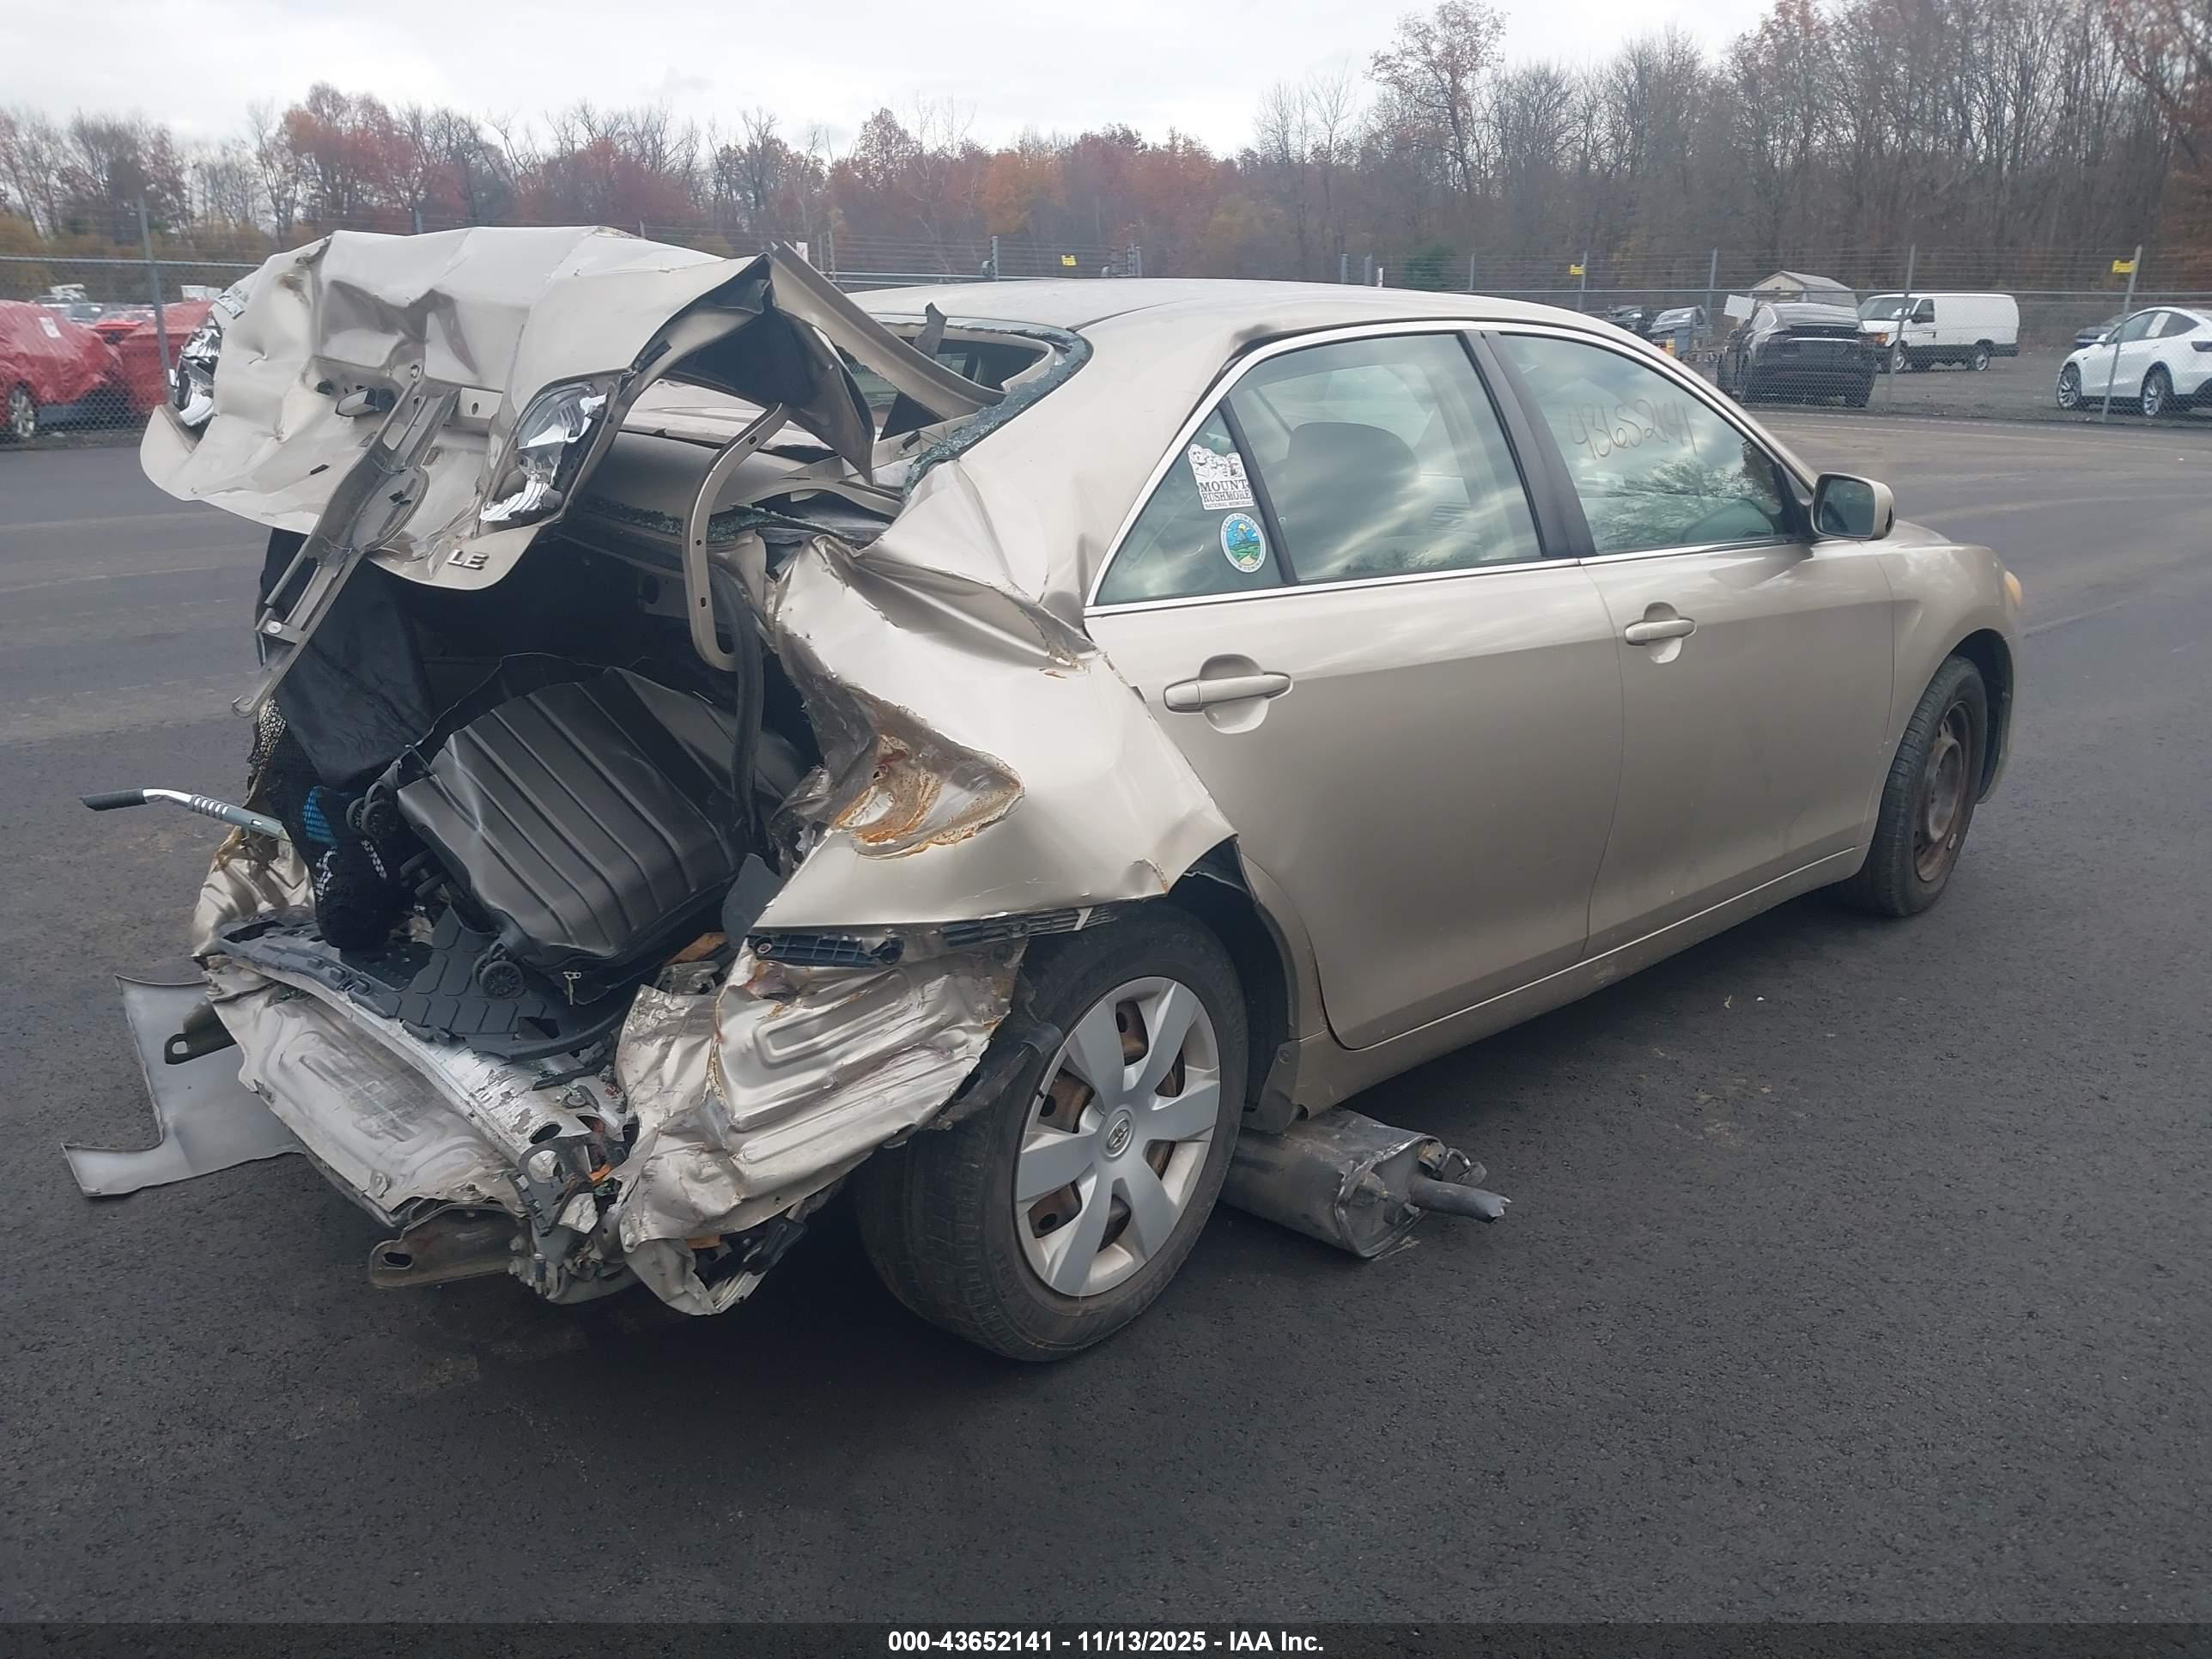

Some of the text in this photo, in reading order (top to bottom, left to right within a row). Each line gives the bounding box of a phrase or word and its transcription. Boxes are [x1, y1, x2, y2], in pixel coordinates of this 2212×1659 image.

[1199, 479, 1248, 492] MOUNT
[1202, 489, 1252, 502] RUSHMORE
[447, 549, 489, 570] LE
